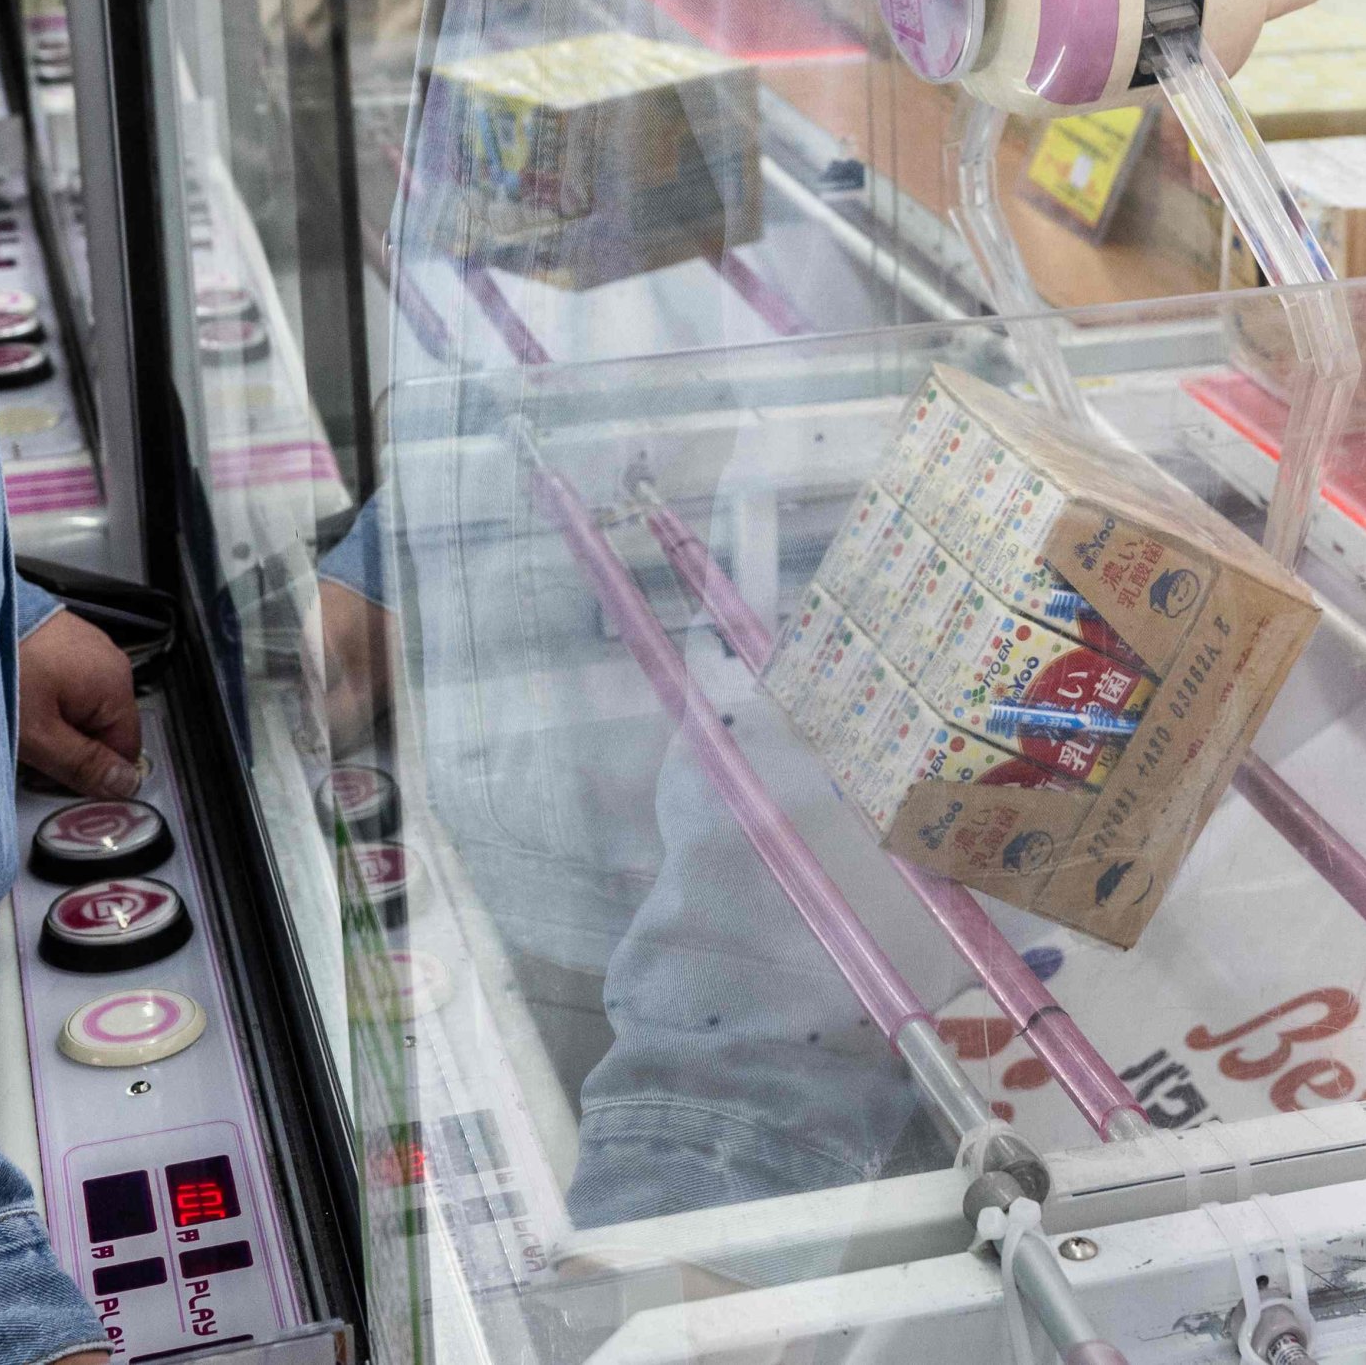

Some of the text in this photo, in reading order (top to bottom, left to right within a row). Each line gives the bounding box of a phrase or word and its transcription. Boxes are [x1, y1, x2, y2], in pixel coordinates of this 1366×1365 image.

[982, 638, 1015, 688] ITO EN
[185, 1279, 219, 1337] PLAY
